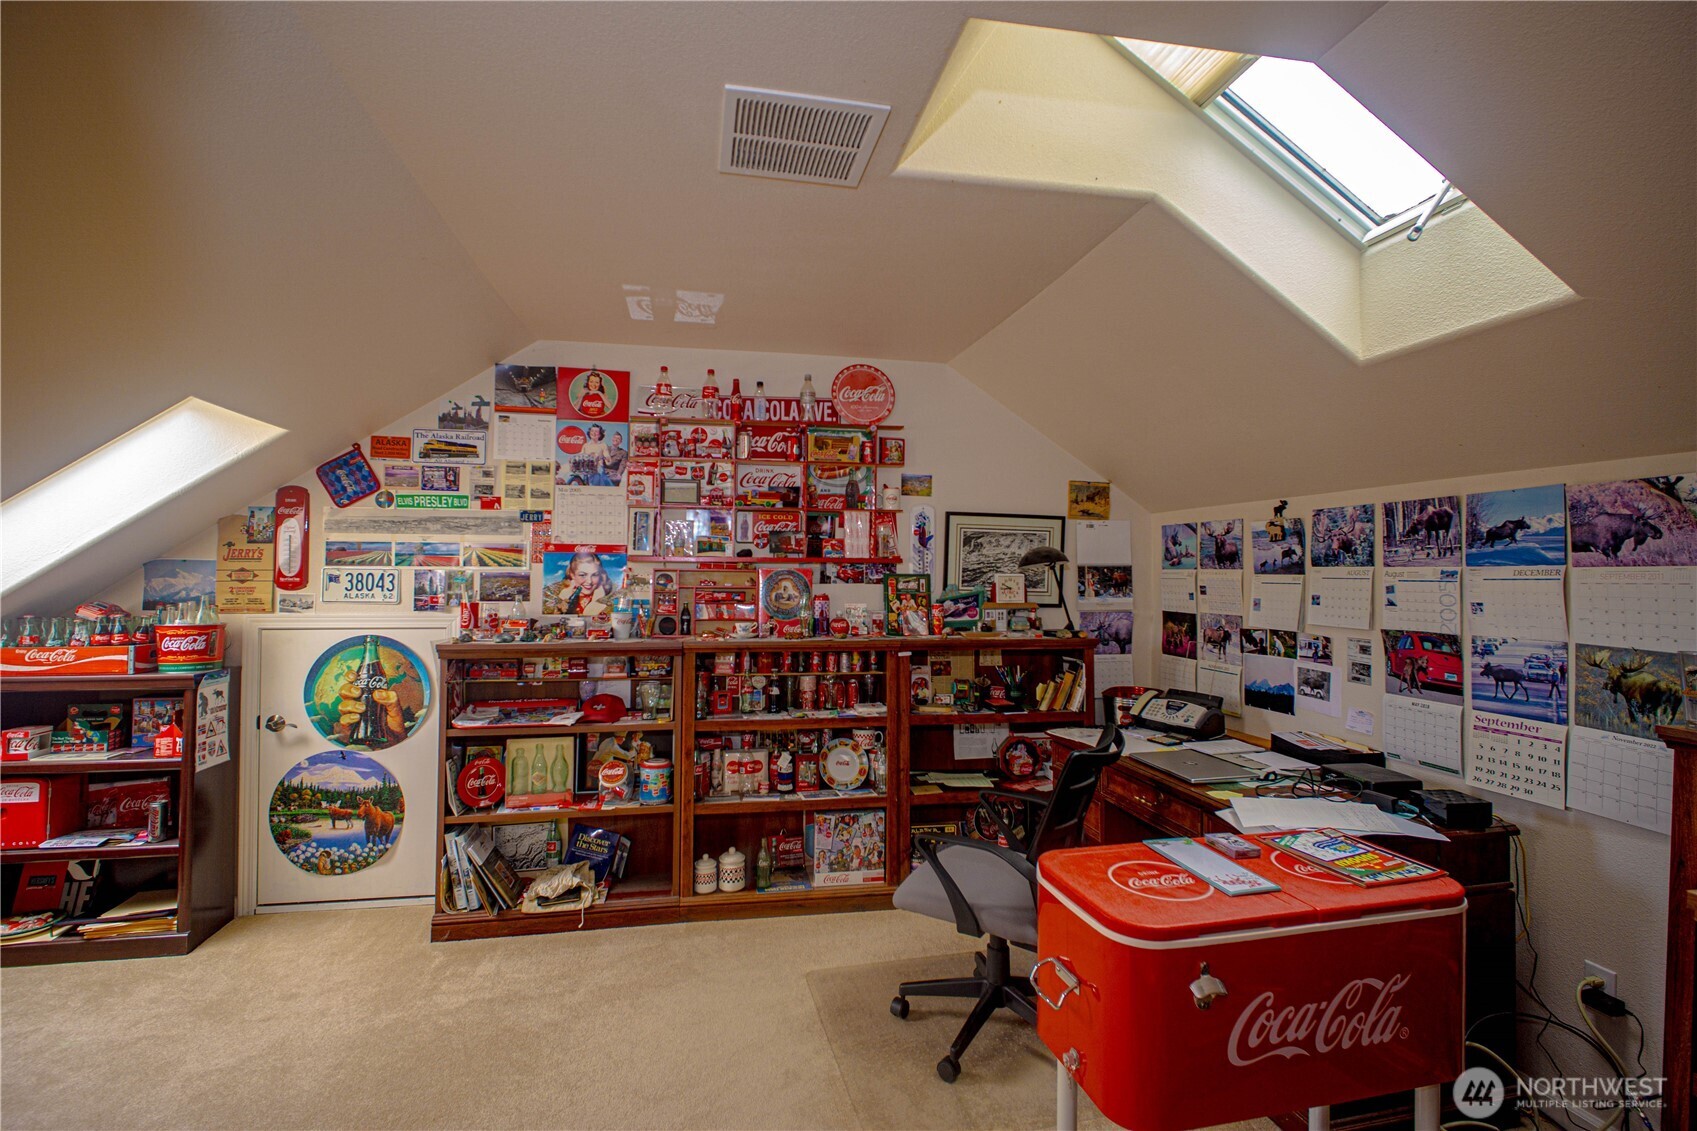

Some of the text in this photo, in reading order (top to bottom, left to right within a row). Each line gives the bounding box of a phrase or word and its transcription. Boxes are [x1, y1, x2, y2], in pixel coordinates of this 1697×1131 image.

[840, 383, 886, 402] Coca-Cola
[455, 433, 485, 441] Railroad
[558, 435, 584, 444] Coca-Cola
[740, 472, 798, 488] Coca-Cola
[398, 496, 467, 508] ELVIS PRESLEY BLVD
[278, 506, 304, 515] Coca-Cola
[520, 512, 543, 521] JERRY
[754, 521, 798, 534] Coca-Cola
[222, 547, 264, 561] JERRY'S
[1384, 571, 1405, 579] August
[344, 572, 395, 592] 38043
[162, 634, 208, 651] Coca-Cola
[25, 649, 78, 662] Coca-Cola
[1474, 714, 1542, 733] September
[1612, 735, 1642, 746] November
[601, 767, 624, 776] Coca-Cola
[468, 775, 496, 788] Coca-Cola
[1472, 775, 1482, 783] 26
[1524, 777, 1534, 785] 23
[1536, 780, 1547, 788] 24
[577, 832, 611, 846] Discover
[575, 840, 588, 849] the
[589, 844, 609, 854] Stars
[1128, 873, 1196, 889] Coca-Cola
[1227, 973, 1411, 1067] Coca-Cola
